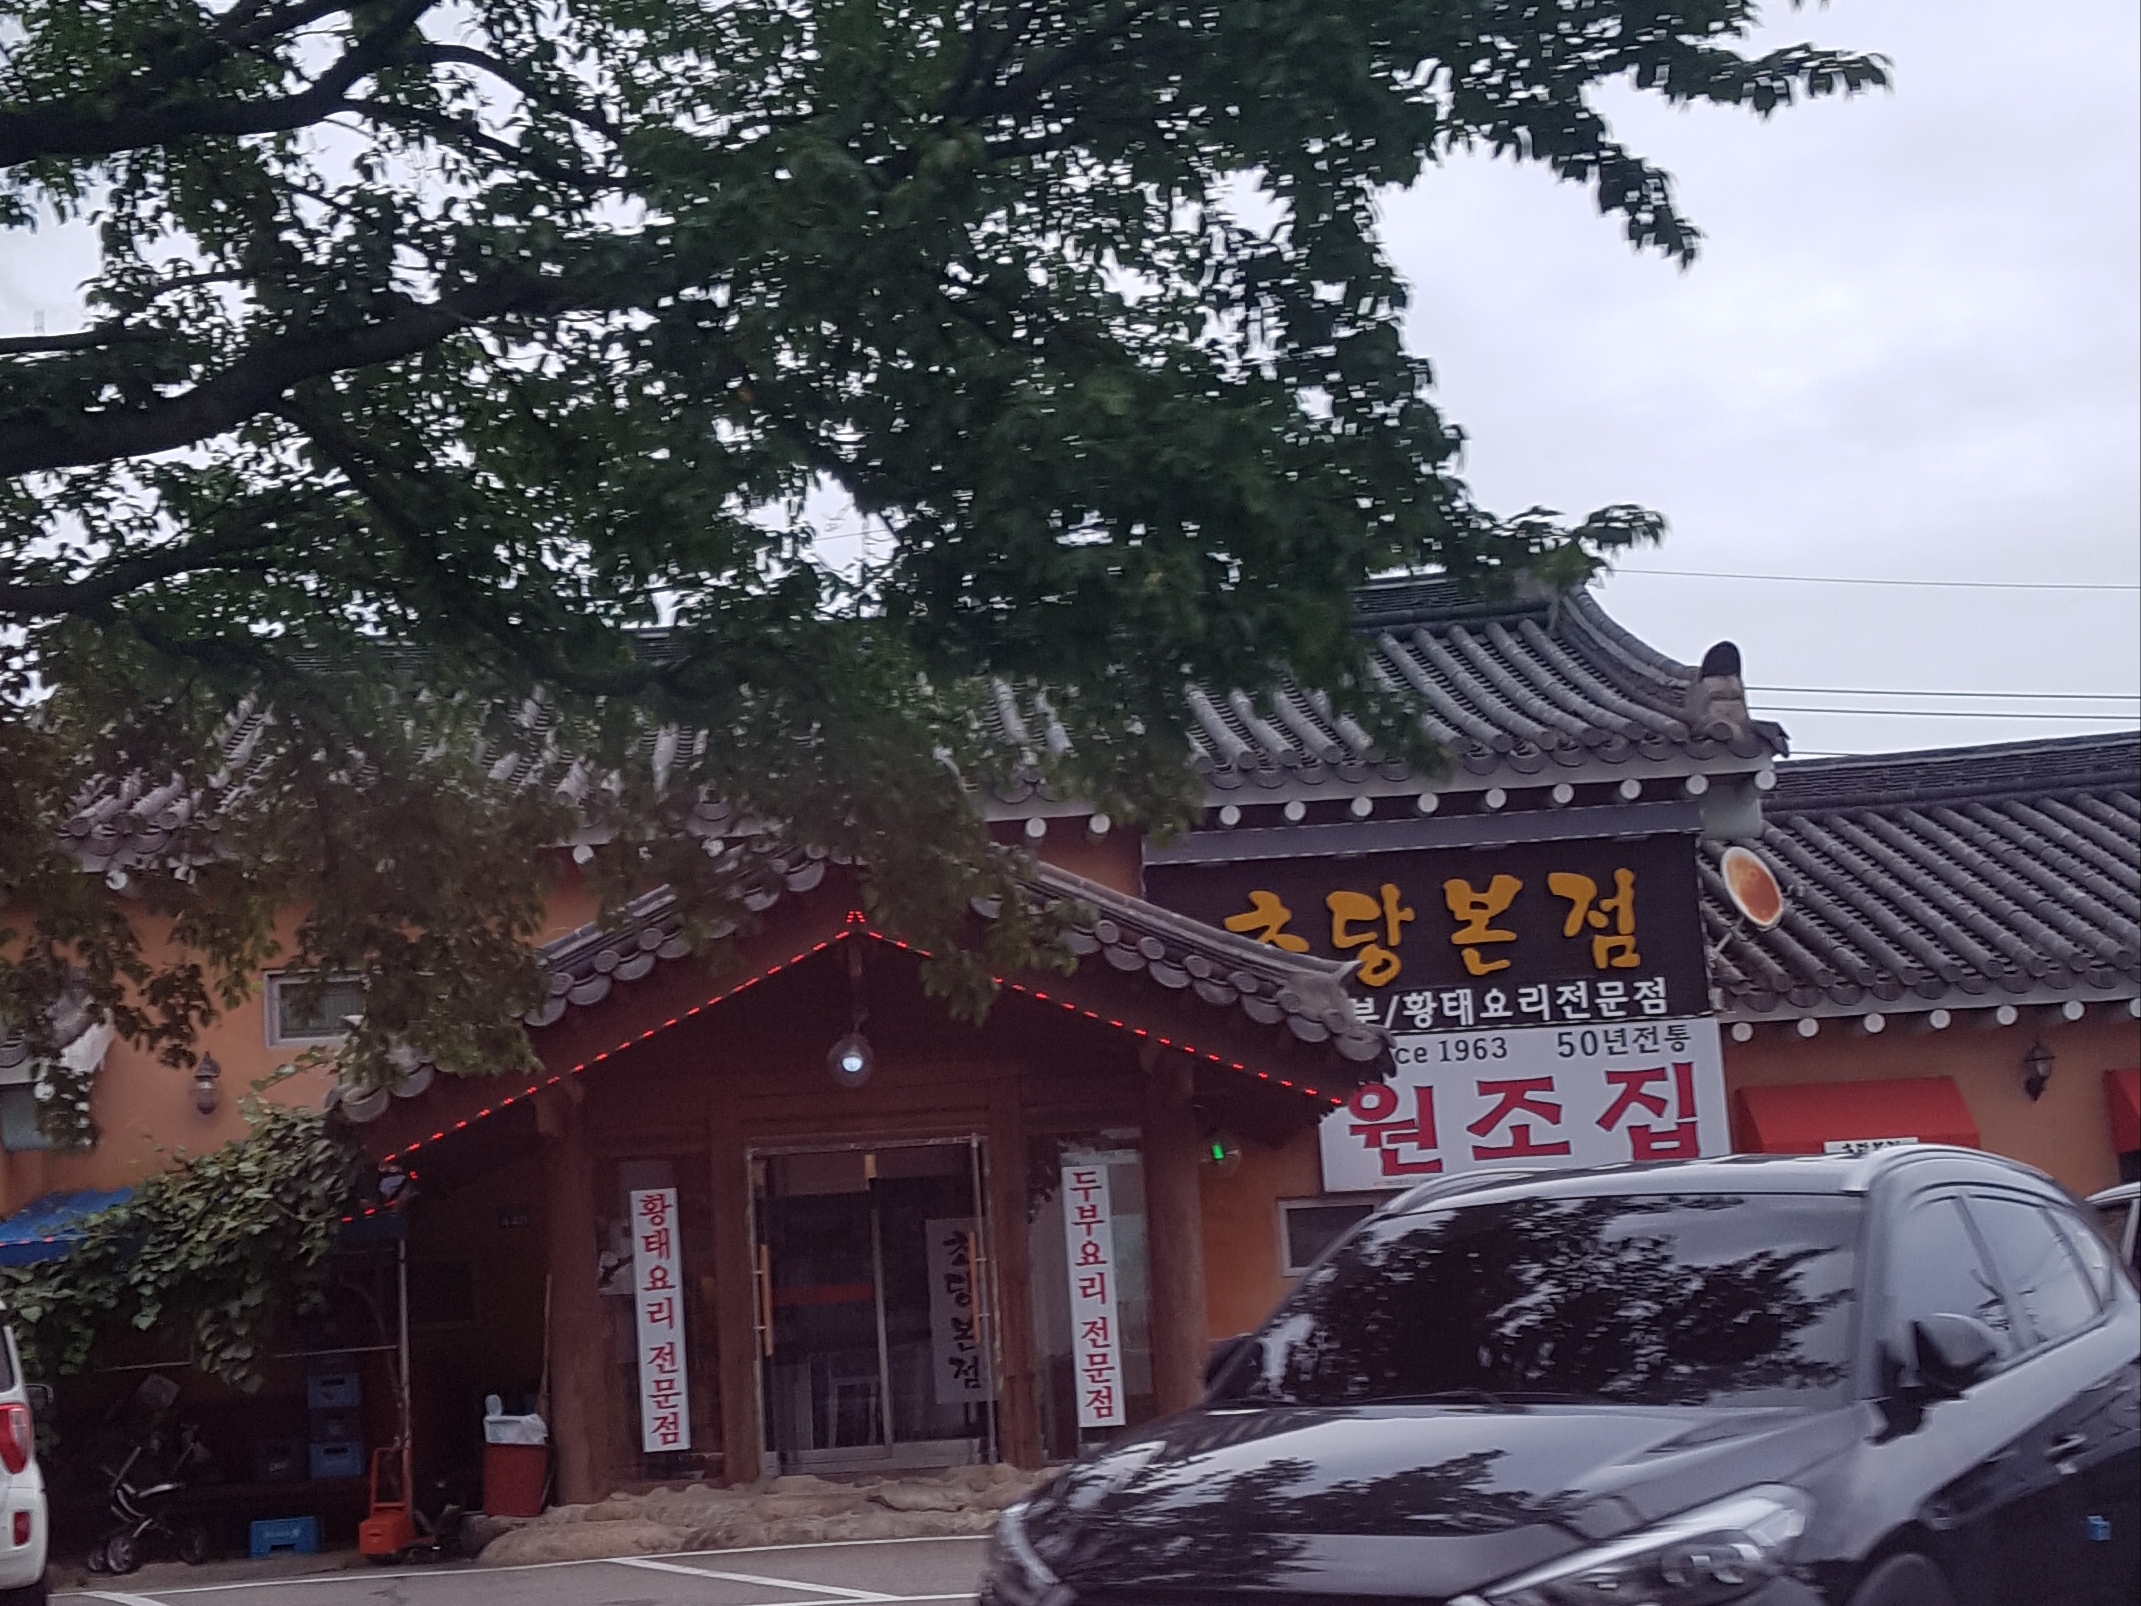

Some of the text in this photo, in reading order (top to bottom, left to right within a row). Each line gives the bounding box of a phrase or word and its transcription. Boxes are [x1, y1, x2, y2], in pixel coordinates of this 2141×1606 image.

[1352, 977, 1668, 1030] 부/황태요리전문점
[1556, 1025, 1692, 1060] 50년전통
[1397, 1036, 1509, 1067] ce 1963
[1348, 1061, 1700, 1177] 원조집
[638, 1193, 684, 1447] 황태요리 전문점
[1069, 1171, 1116, 1420] 두부요리 전문점
